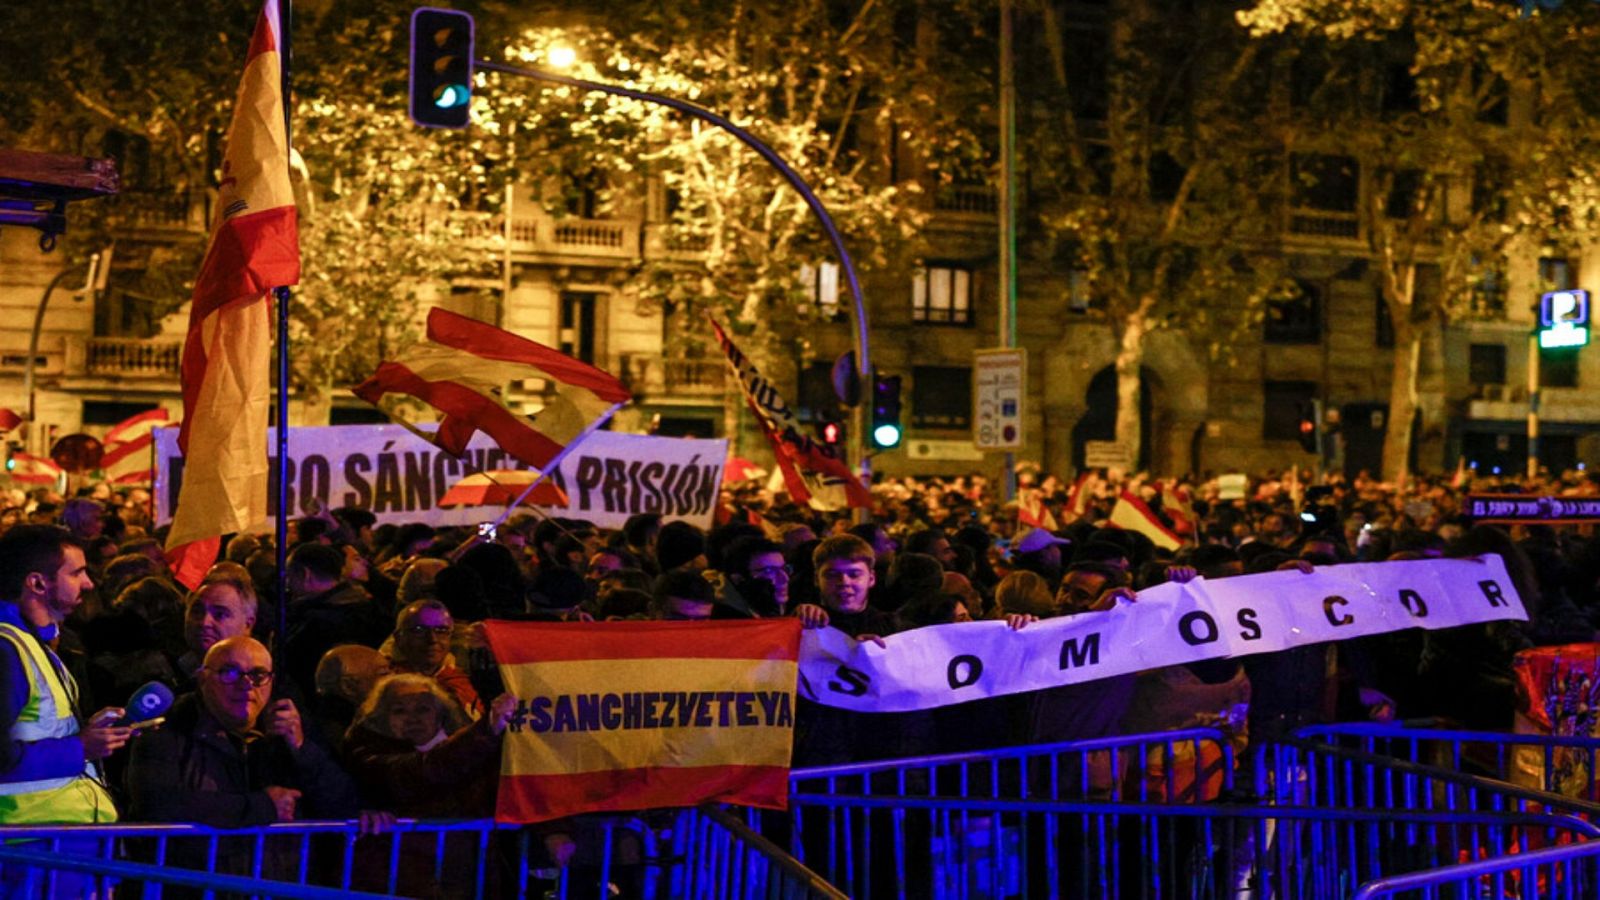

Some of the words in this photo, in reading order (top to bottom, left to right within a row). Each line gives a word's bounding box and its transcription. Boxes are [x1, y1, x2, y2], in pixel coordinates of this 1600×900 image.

[344, 441, 530, 513] SÁNC
[577, 454, 719, 516] PRISIÓN
[509, 692, 793, 733] #SANCHEZVETEYA
